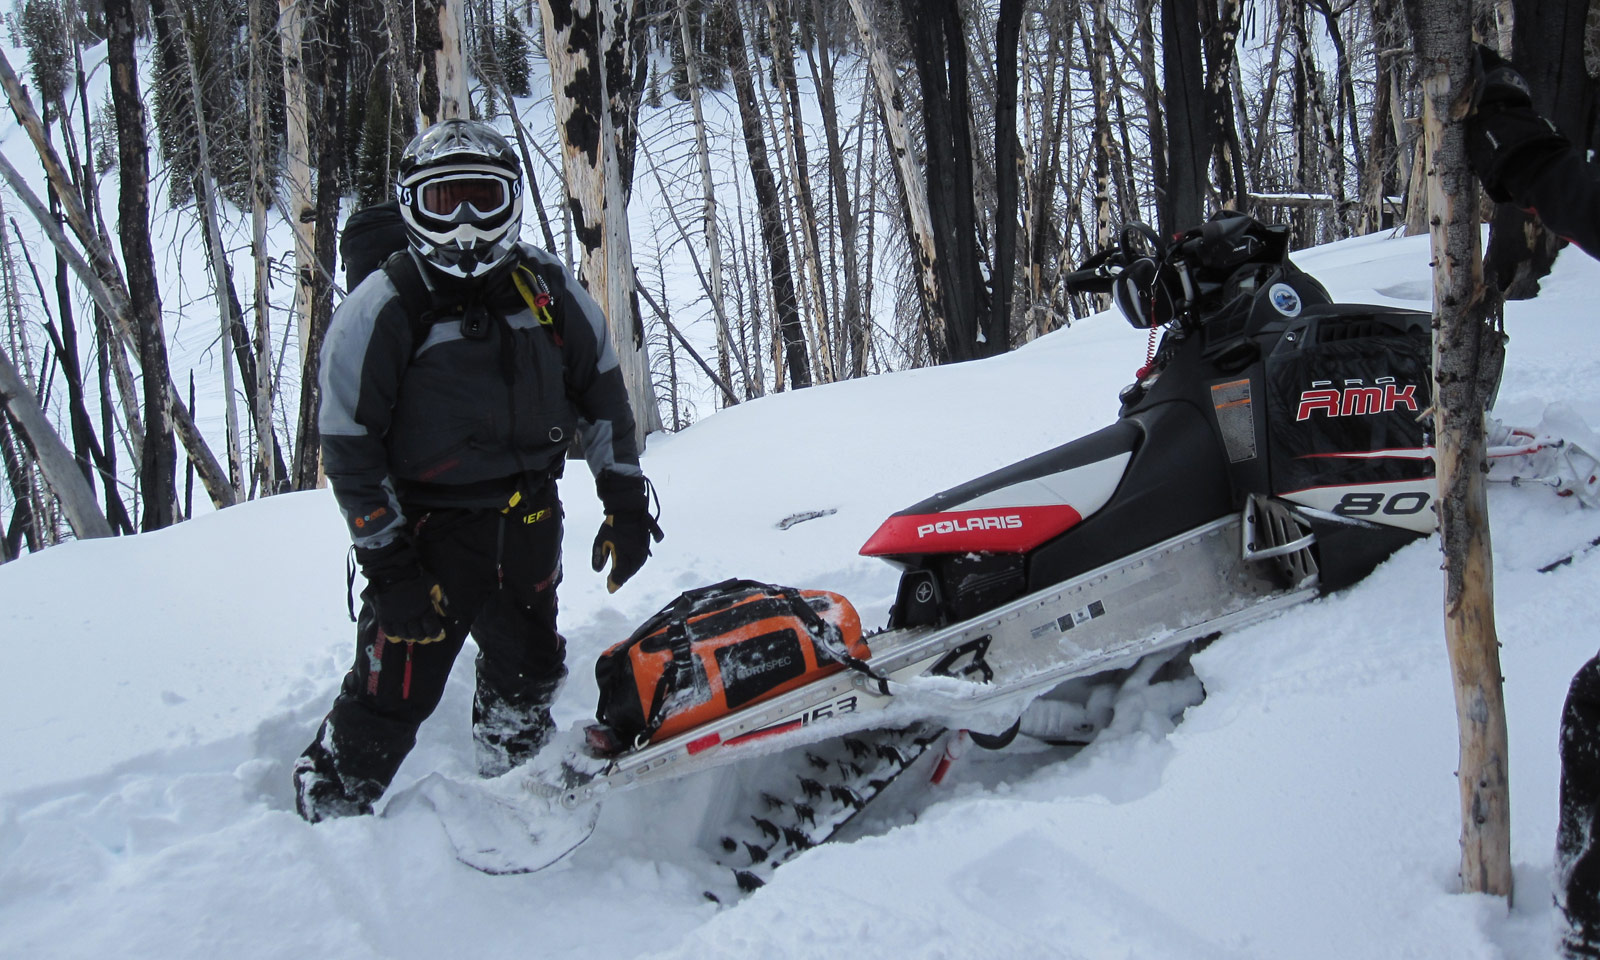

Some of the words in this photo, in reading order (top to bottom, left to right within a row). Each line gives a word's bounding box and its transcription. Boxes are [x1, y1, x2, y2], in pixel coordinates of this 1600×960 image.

[1296, 384, 1418, 422] RMK
[1331, 491, 1435, 516] 80
[917, 514, 1023, 539] POLARIS
